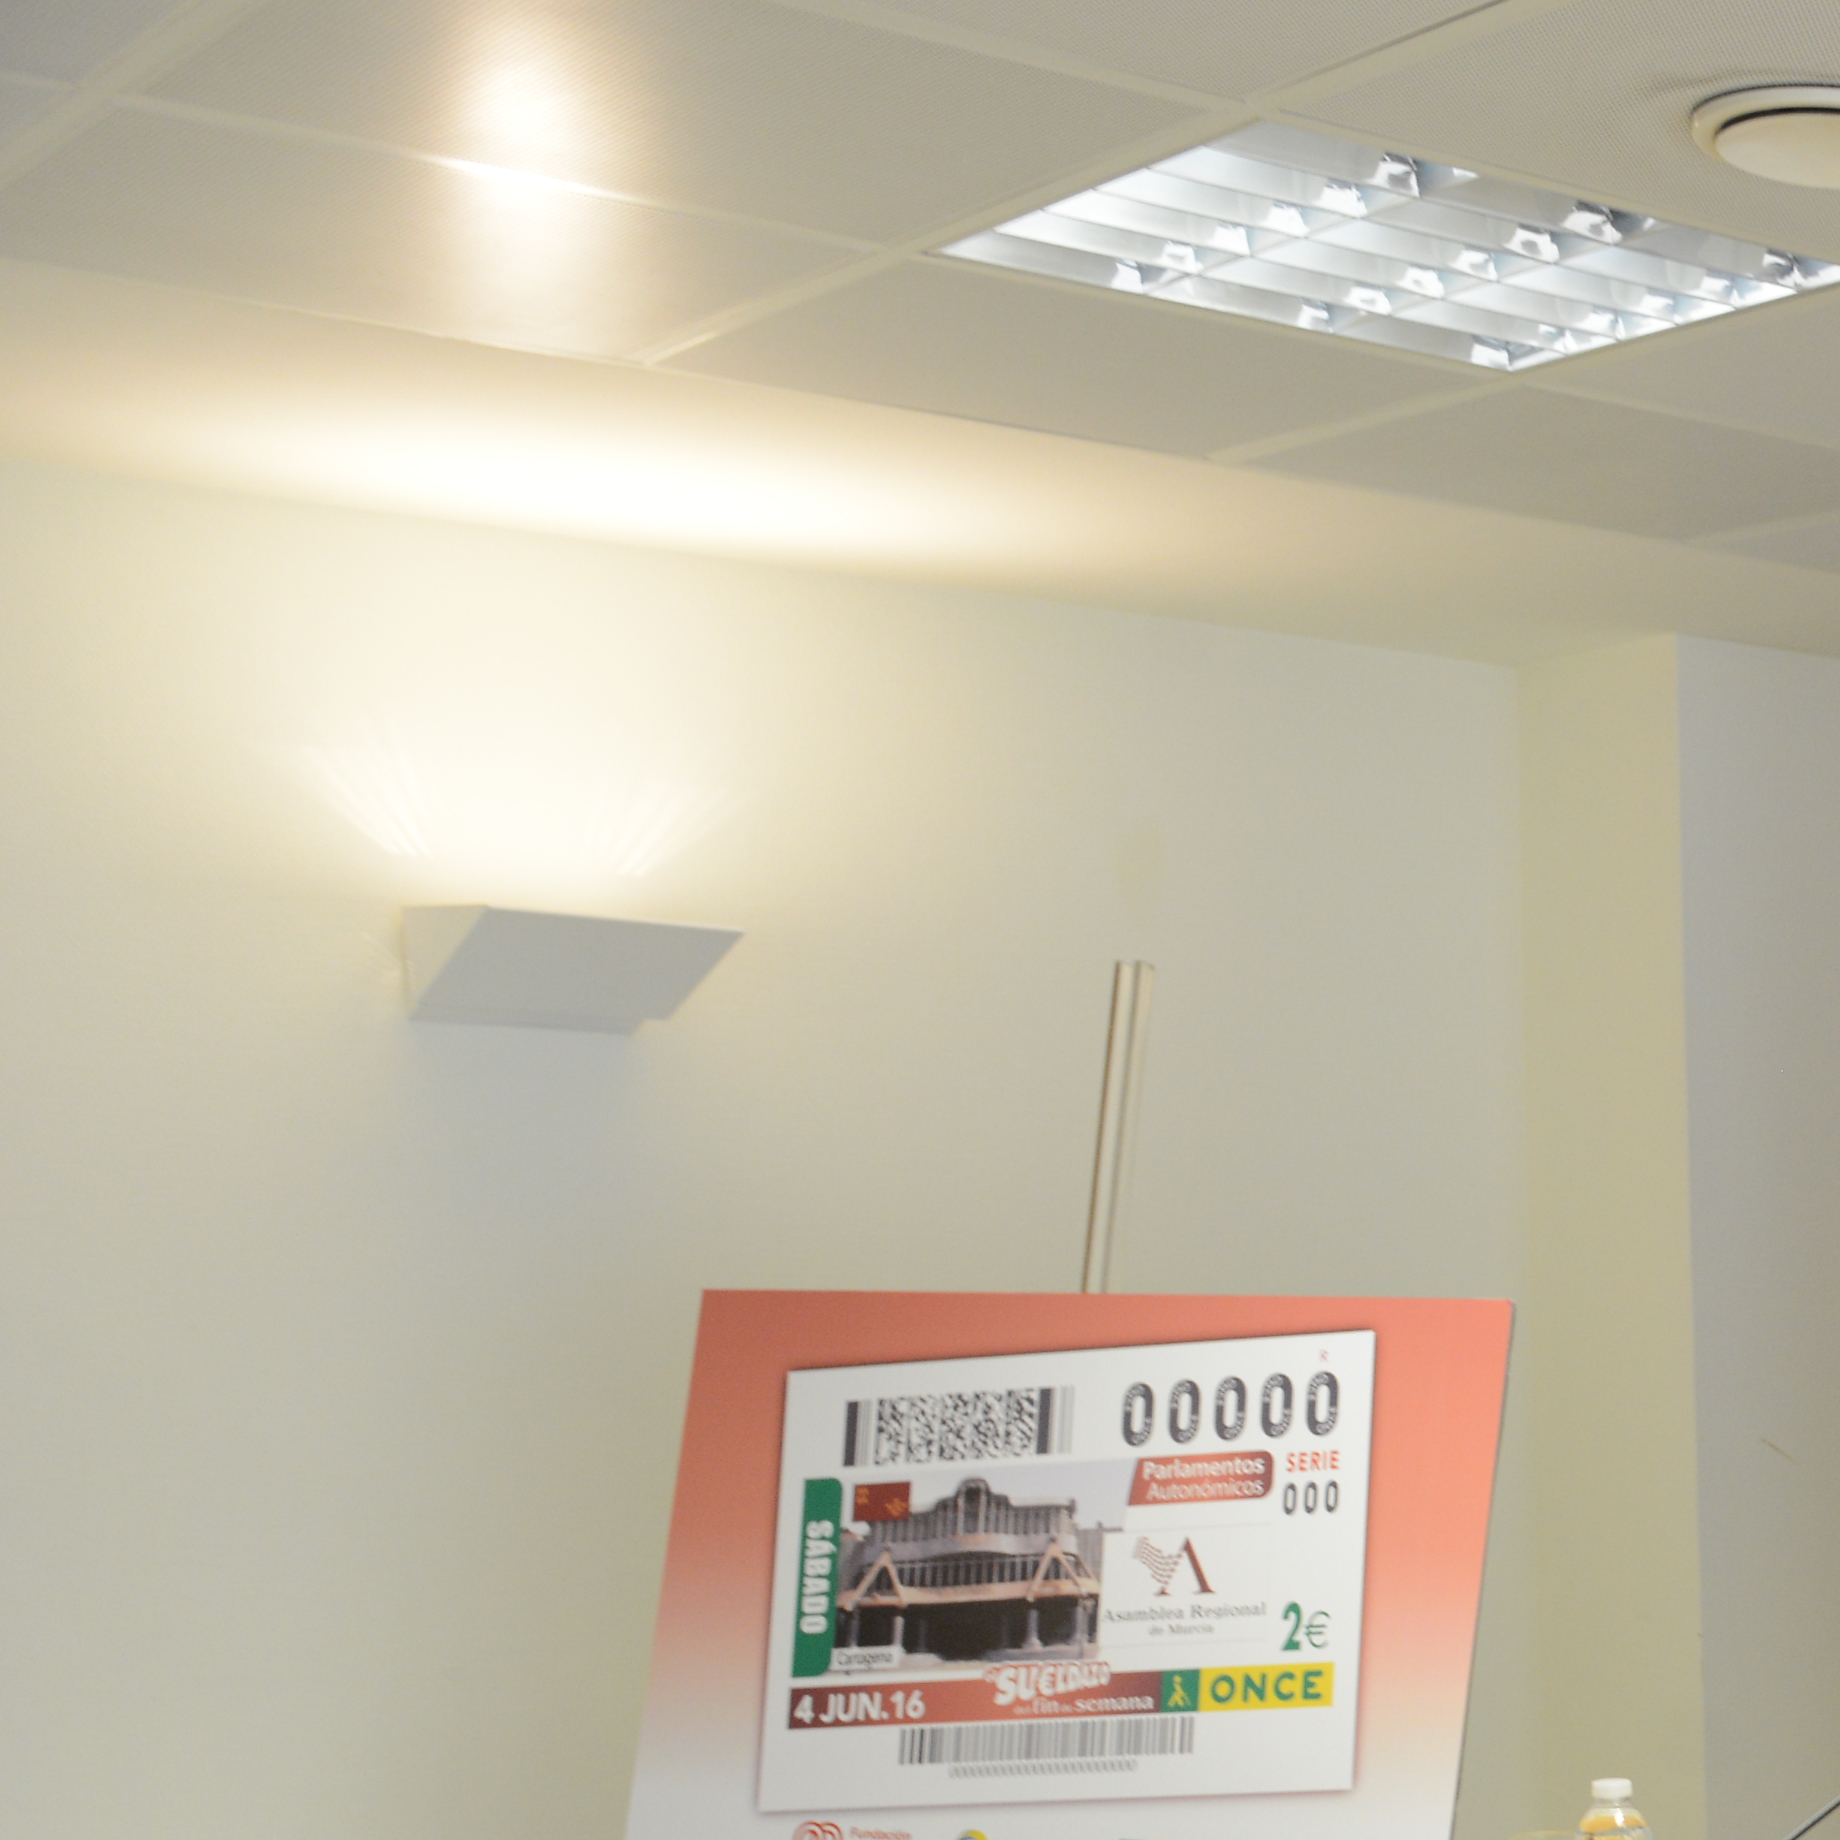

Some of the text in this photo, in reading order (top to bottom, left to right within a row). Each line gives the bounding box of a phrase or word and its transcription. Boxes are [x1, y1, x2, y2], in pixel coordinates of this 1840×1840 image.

[1122, 1371, 1339, 1447] 00000
[1142, 1457, 1266, 1480] Parlamentos
[1286, 1450, 1341, 1472] SERIE
[1146, 1479, 1265, 1501] Autonómicos
[1283, 1480, 1339, 1515] 000
[800, 1520, 838, 1634] SÁBADO
[1103, 1601, 1268, 1623] Asamblea Regional
[1149, 1622, 1215, 1636] de Murcia
[1281, 1601, 1331, 1651] 2€
[1210, 1669, 1325, 1705] ONCE
[793, 1694, 816, 1724] 4
[1074, 1694, 1155, 1713] semana
